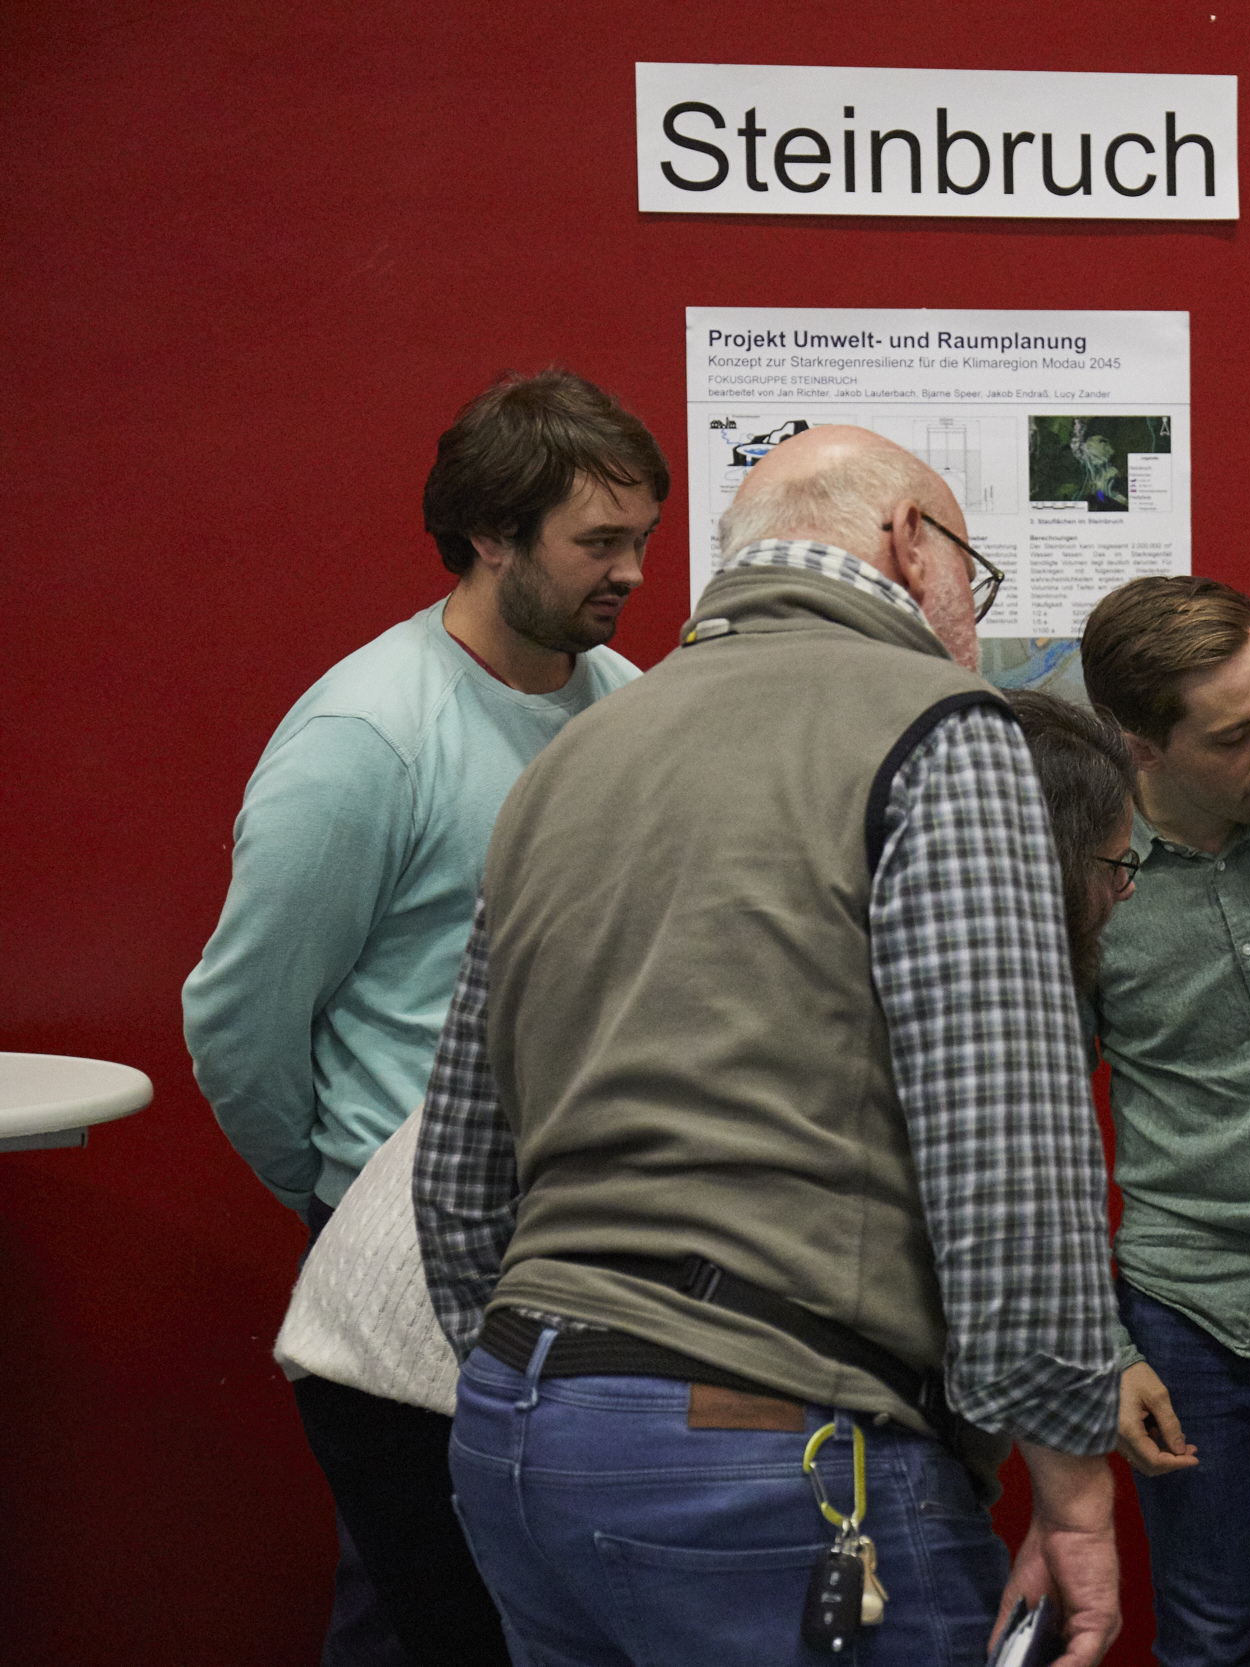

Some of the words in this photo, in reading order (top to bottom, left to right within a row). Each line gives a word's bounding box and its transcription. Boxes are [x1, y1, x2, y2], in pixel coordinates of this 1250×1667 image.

[660, 101, 1216, 197] Steinbruch
[709, 329, 786, 351] Projekt
[794, 330, 882, 348] Umwelt-
[890, 332, 929, 348] und
[938, 332, 1087, 354] Raumplanung
[708, 355, 762, 369] Konzept
[766, 357, 786, 367] zur
[790, 356, 914, 370] Starkregenresilienz
[919, 357, 934, 368] für
[939, 357, 958, 368] die
[963, 357, 1037, 371] Klimaregion
[1042, 358, 1085, 369] Modau
[1089, 358, 1121, 369] 2045
[708, 375, 787, 384] FOKUSGRUPPE
[791, 376, 857, 385] STEINBRUCH
[708, 389, 754, 397] bearbeitet
[777, 389, 793, 397] Jan
[834, 389, 861, 397] Jakob
[986, 389, 1013, 398] Jakob
[1054, 390, 1075, 400] Lucy
[1078, 390, 1110, 398] Zander
